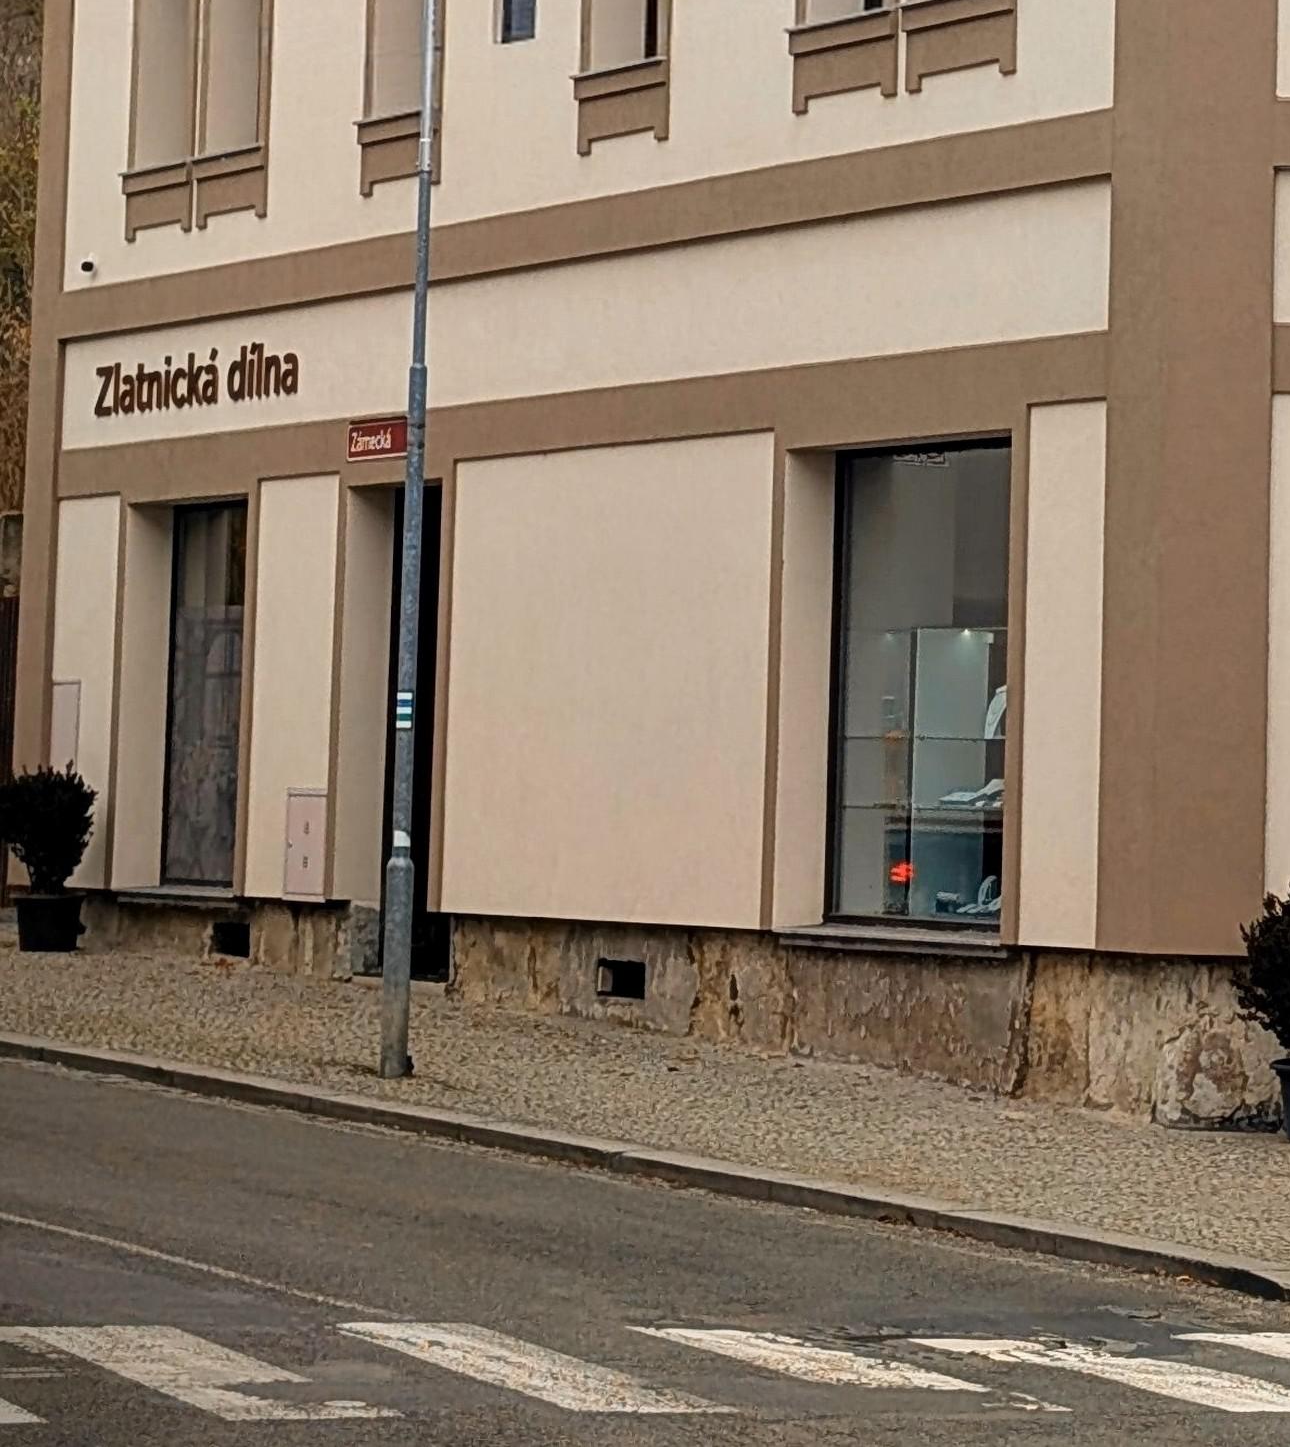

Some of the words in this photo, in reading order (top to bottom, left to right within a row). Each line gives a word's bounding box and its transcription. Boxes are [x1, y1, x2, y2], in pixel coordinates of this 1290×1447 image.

[94, 347, 219, 418] Zlatnická
[227, 341, 299, 402] dílna
[350, 427, 392, 453] Zámecká
